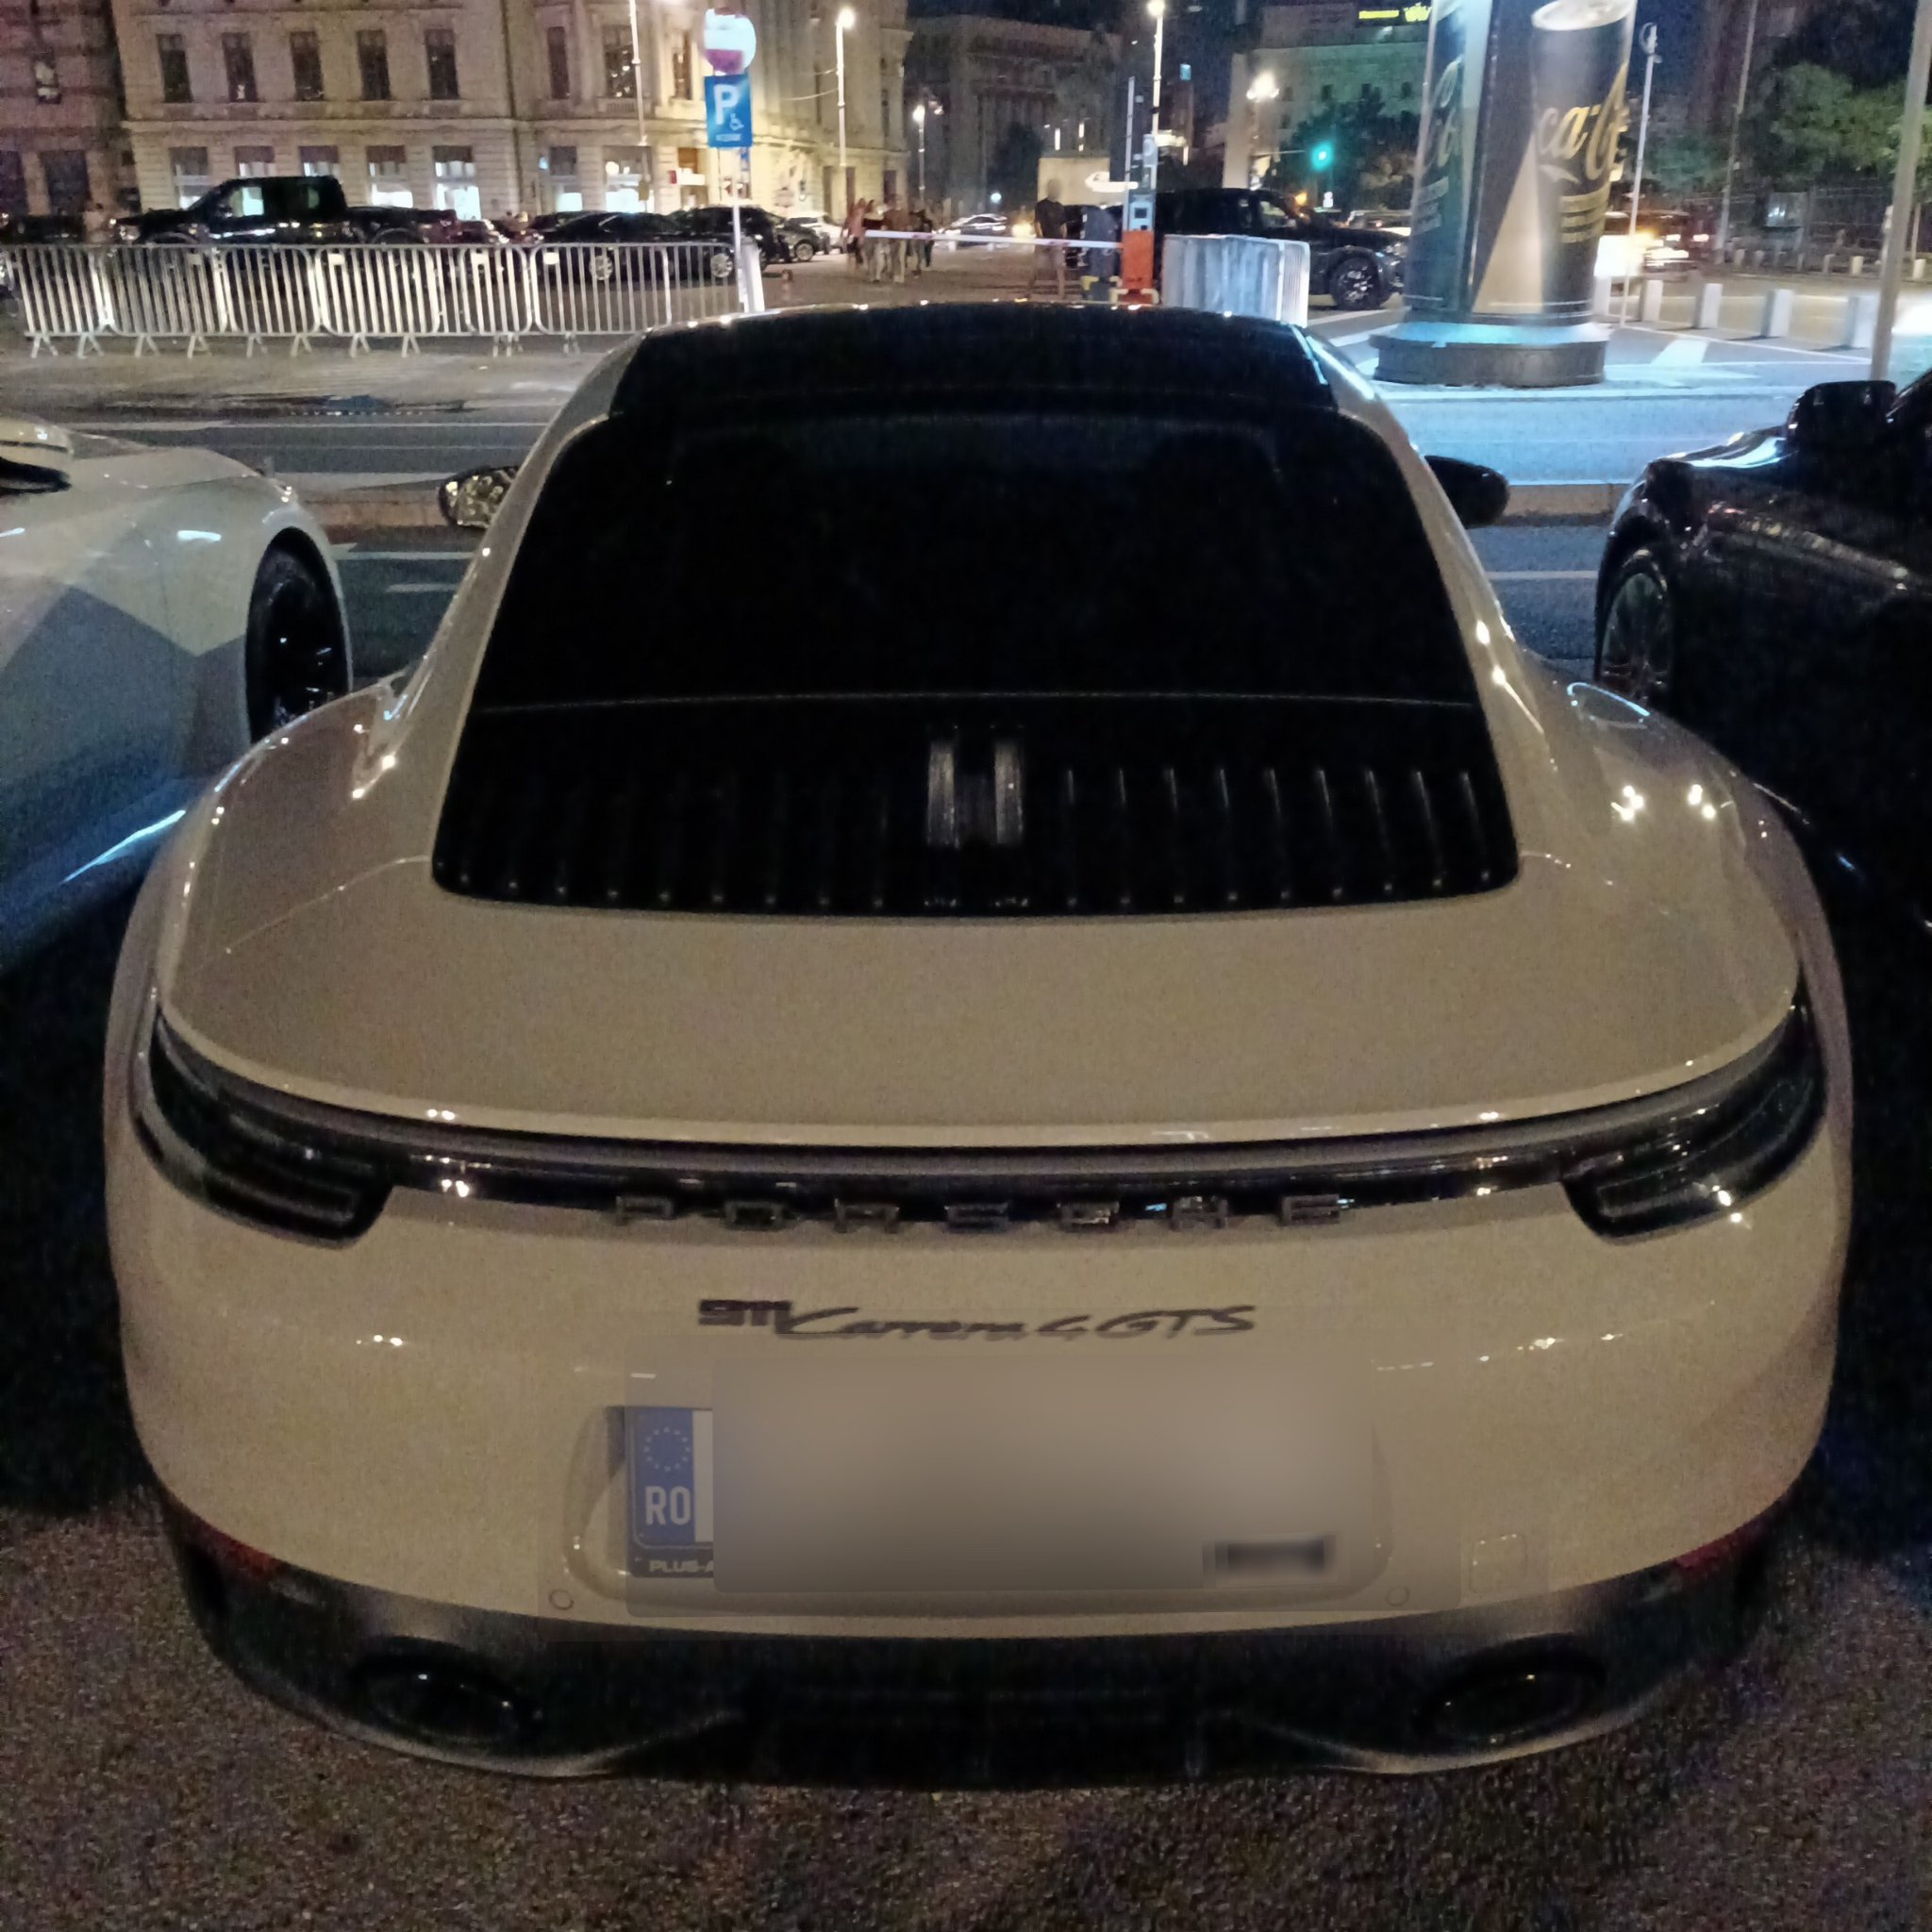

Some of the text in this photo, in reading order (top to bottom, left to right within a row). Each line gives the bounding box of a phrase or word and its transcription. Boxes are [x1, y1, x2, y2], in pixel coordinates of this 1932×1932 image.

[713, 84, 739, 125] P
[615, 1194, 1341, 1234] PORSCHE
[774, 1307, 1026, 1340] Carrera
[1095, 1305, 1257, 1340] GTS
[645, 1485, 691, 1525] RO
